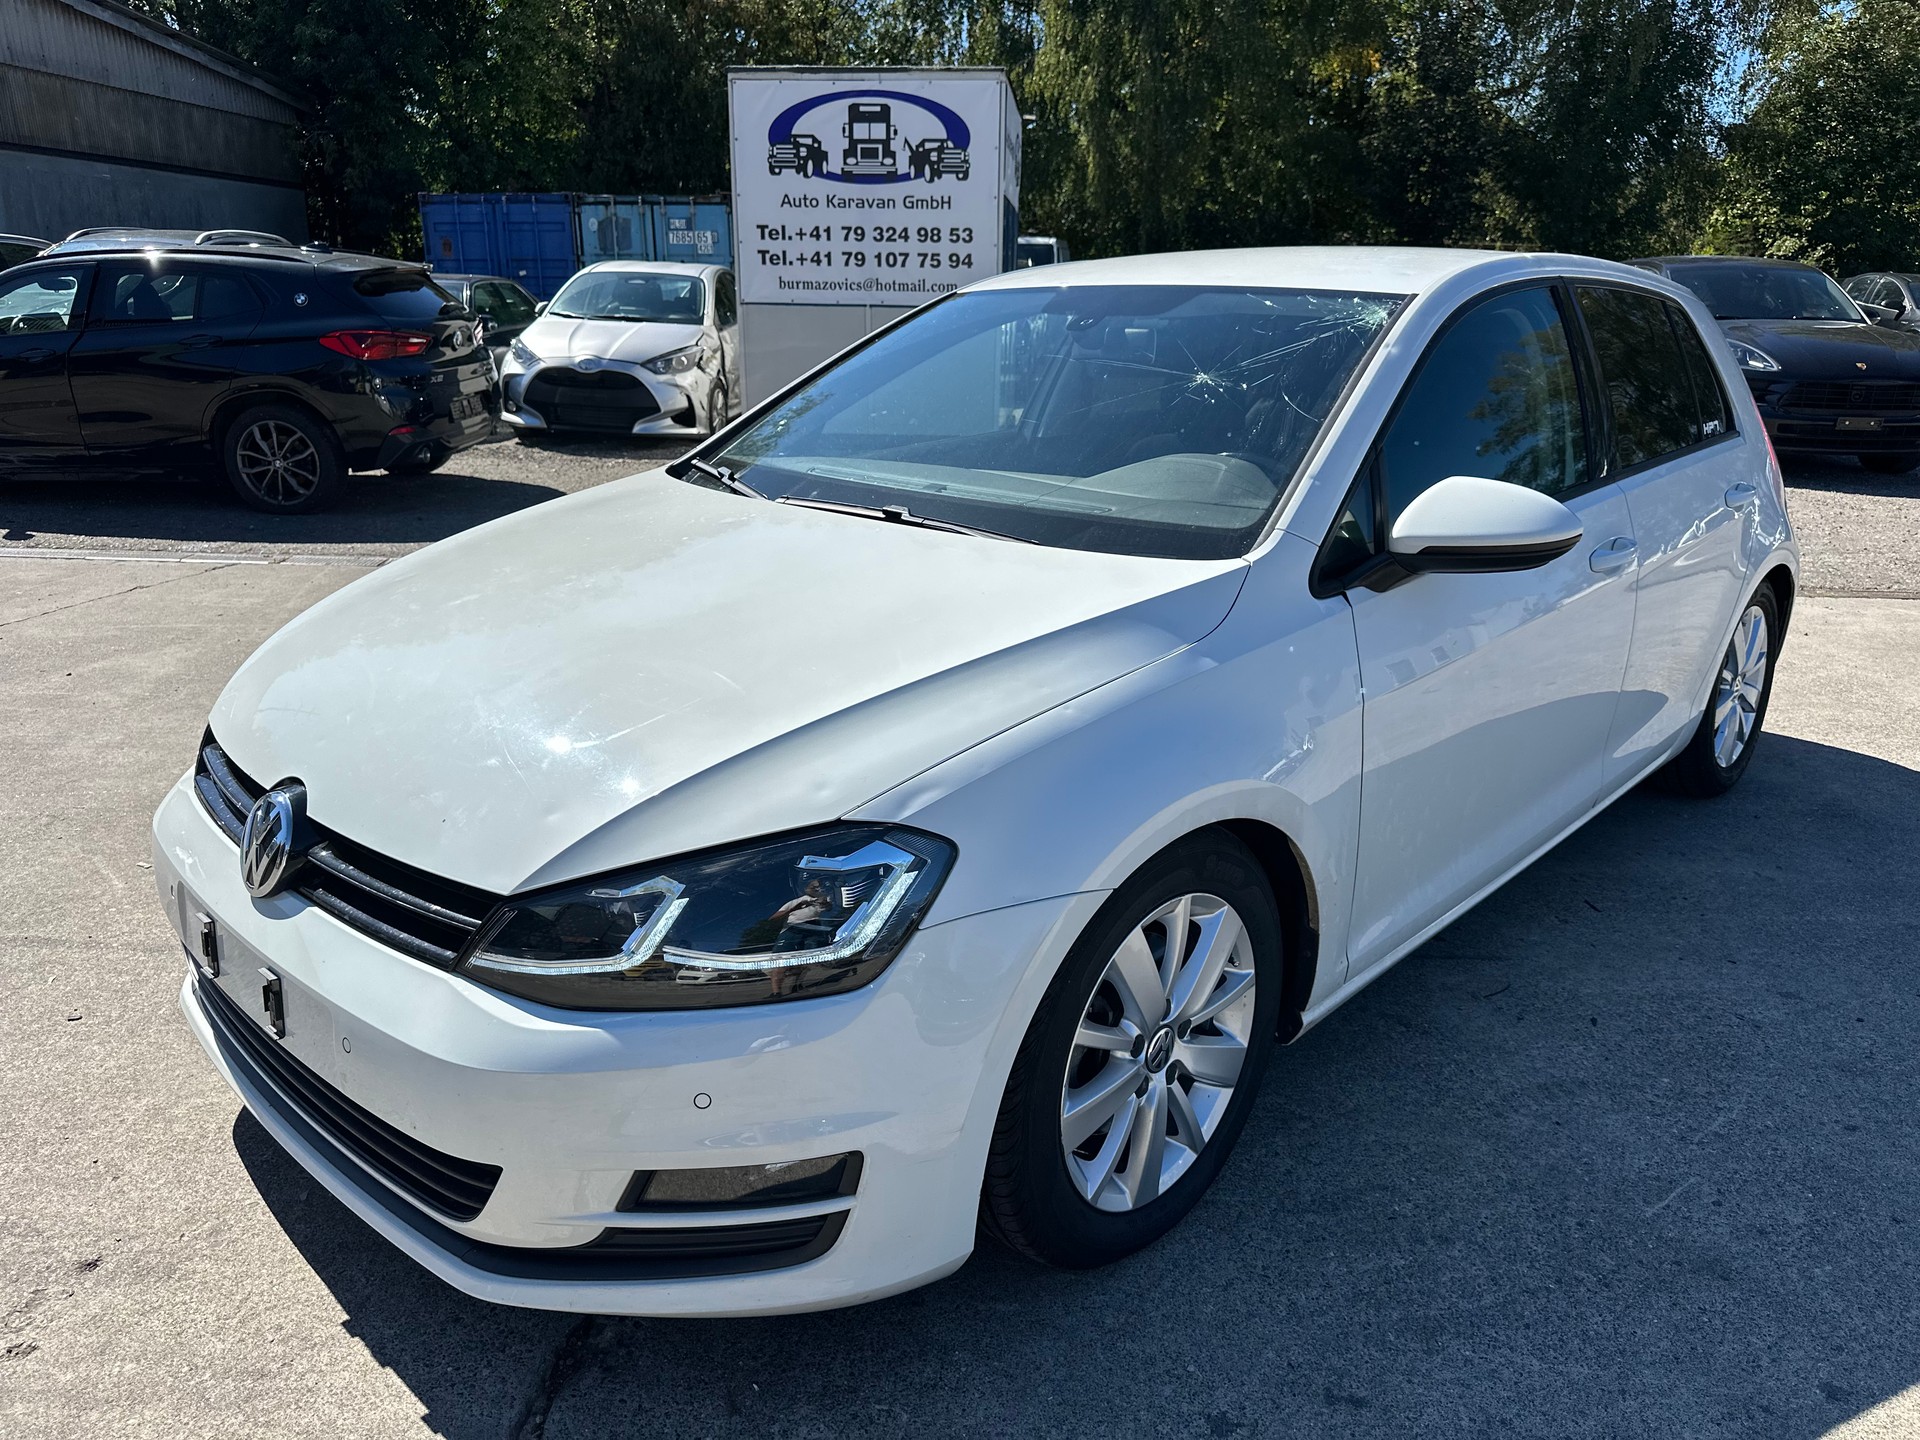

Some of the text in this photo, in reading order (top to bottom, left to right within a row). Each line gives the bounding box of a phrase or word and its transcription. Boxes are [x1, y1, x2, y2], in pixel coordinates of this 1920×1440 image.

[780, 193, 952, 210] Auto Karavan GmbH
[841, 226, 866, 242] 79
[873, 226, 910, 243] 324
[917, 227, 942, 243] 98
[949, 228, 974, 244] 53
[842, 251, 867, 267] 79
[874, 251, 910, 268] 107
[917, 252, 942, 269] 75
[948, 253, 974, 269] 94
[778, 276, 958, 293] burmazovics@hotmail.com
